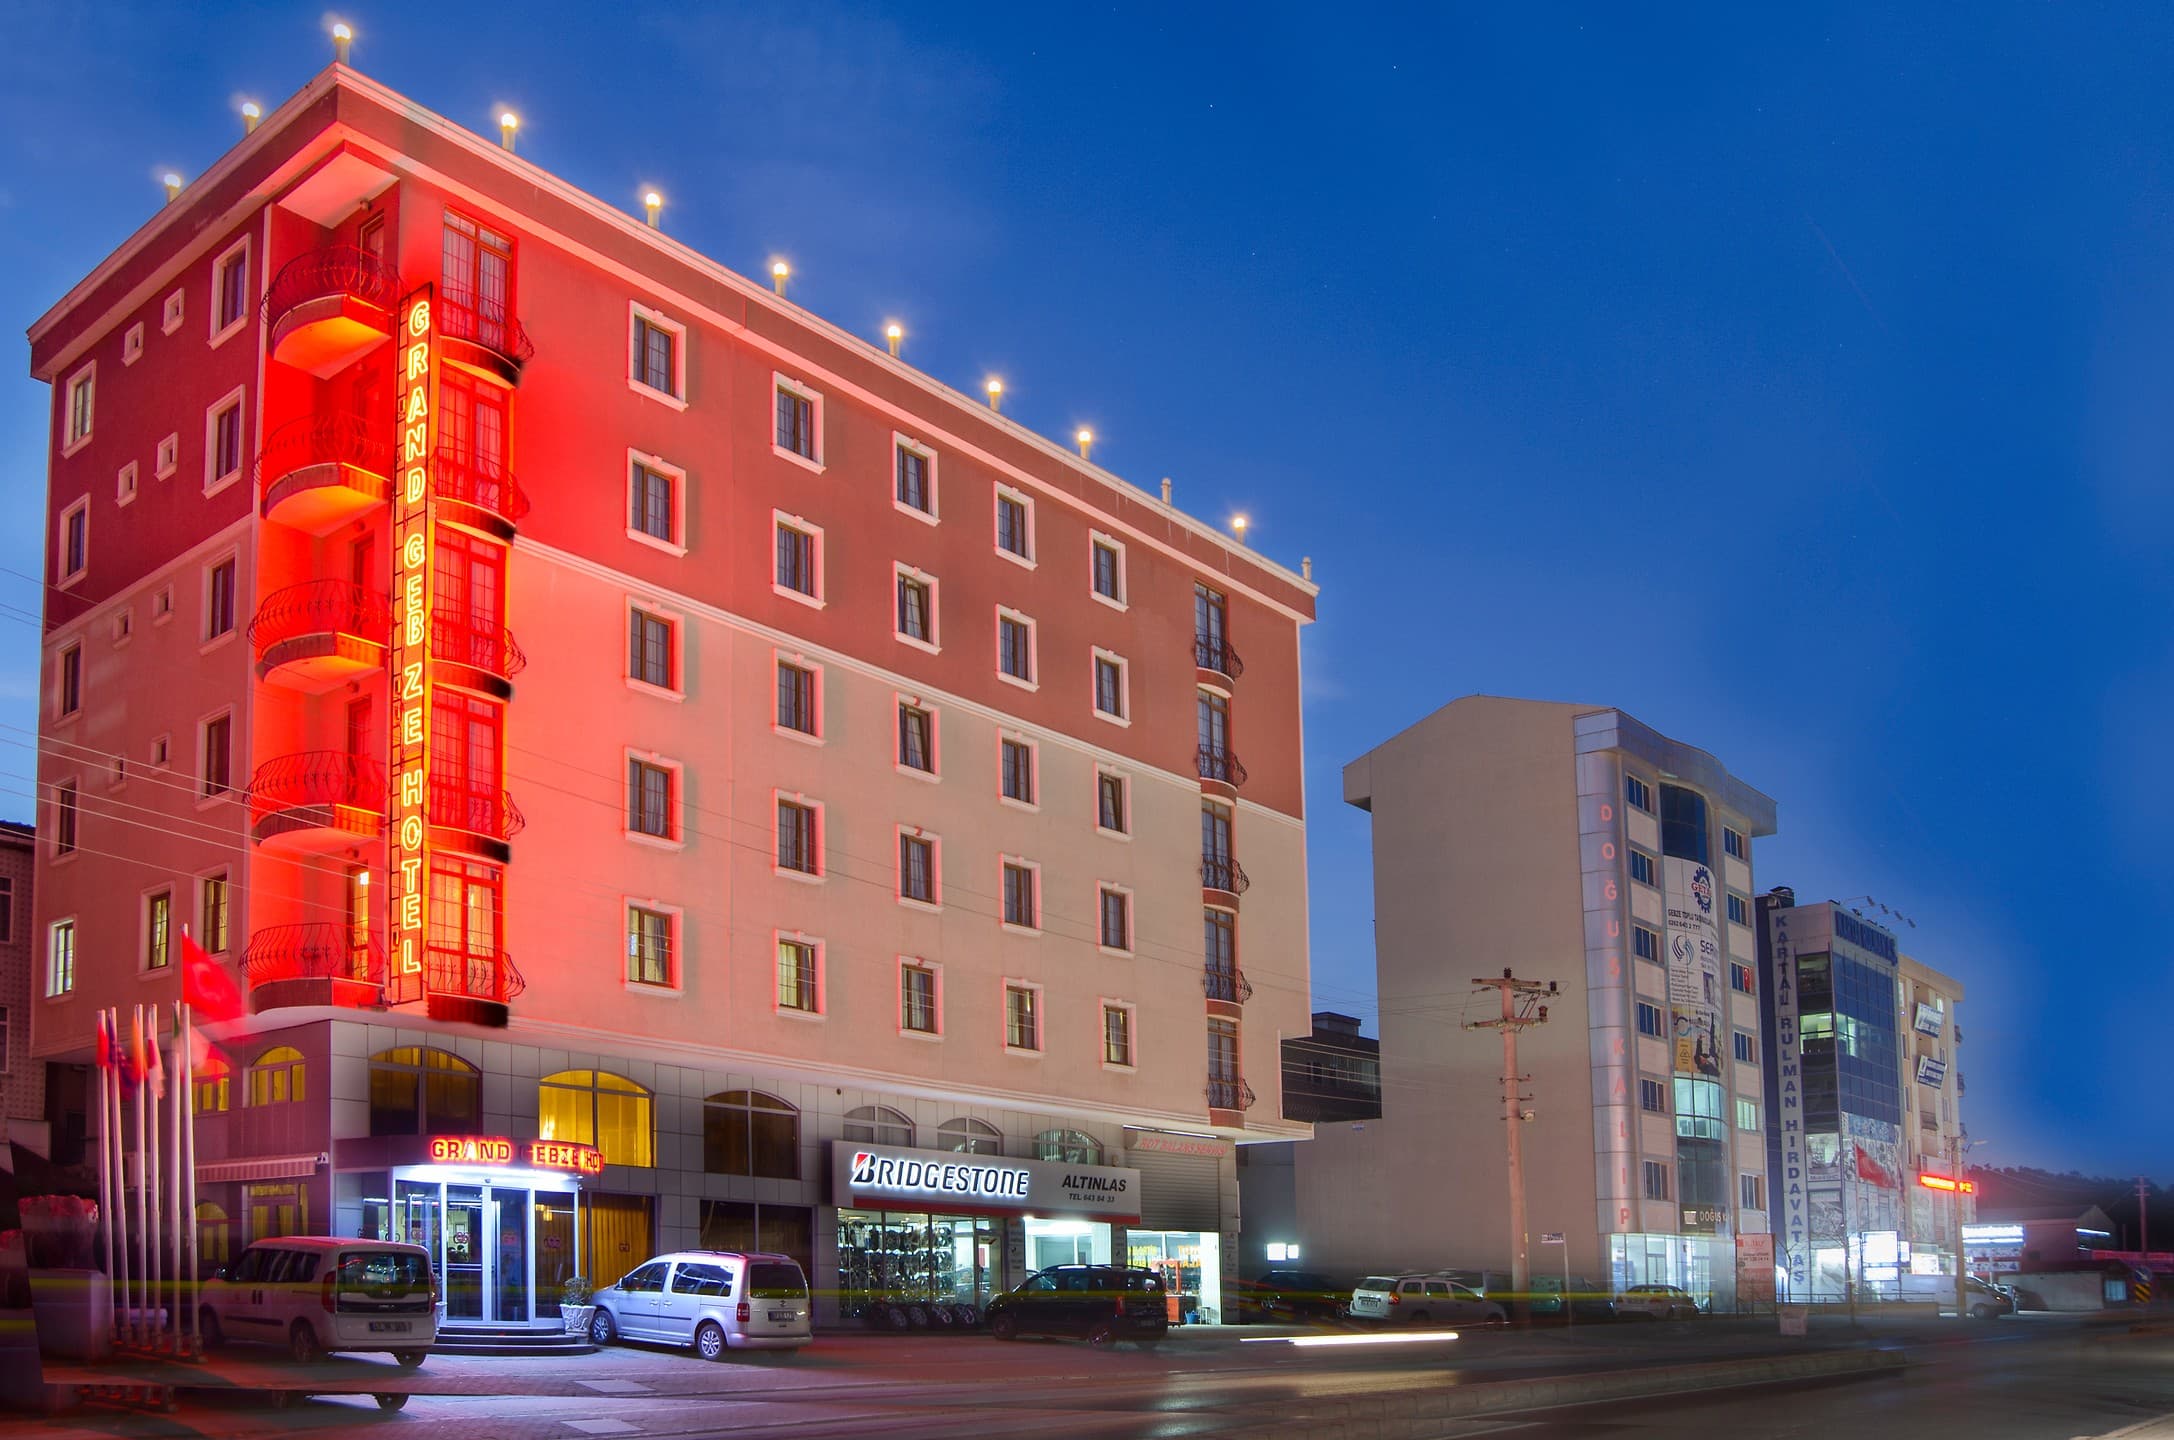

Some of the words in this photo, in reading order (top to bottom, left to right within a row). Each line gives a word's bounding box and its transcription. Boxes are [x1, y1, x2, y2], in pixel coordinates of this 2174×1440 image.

[405, 300, 431, 505] GRAND
[402, 532, 426, 747] GEBZE
[401, 768, 423, 975] HOTEL
[1775, 915, 1791, 1006] KARTAL
[1780, 1018, 1797, 1108] RULMAN
[431, 1140, 511, 1161] GRAND
[519, 1144, 580, 1166] EBZE
[853, 1152, 1030, 1196] BRIDGESTONE
[1061, 1174, 1127, 1192] ALTINLAS
[1613, 1038, 1631, 1225] KALIP
[1785, 1120, 1803, 1243] HIRDAVAT
